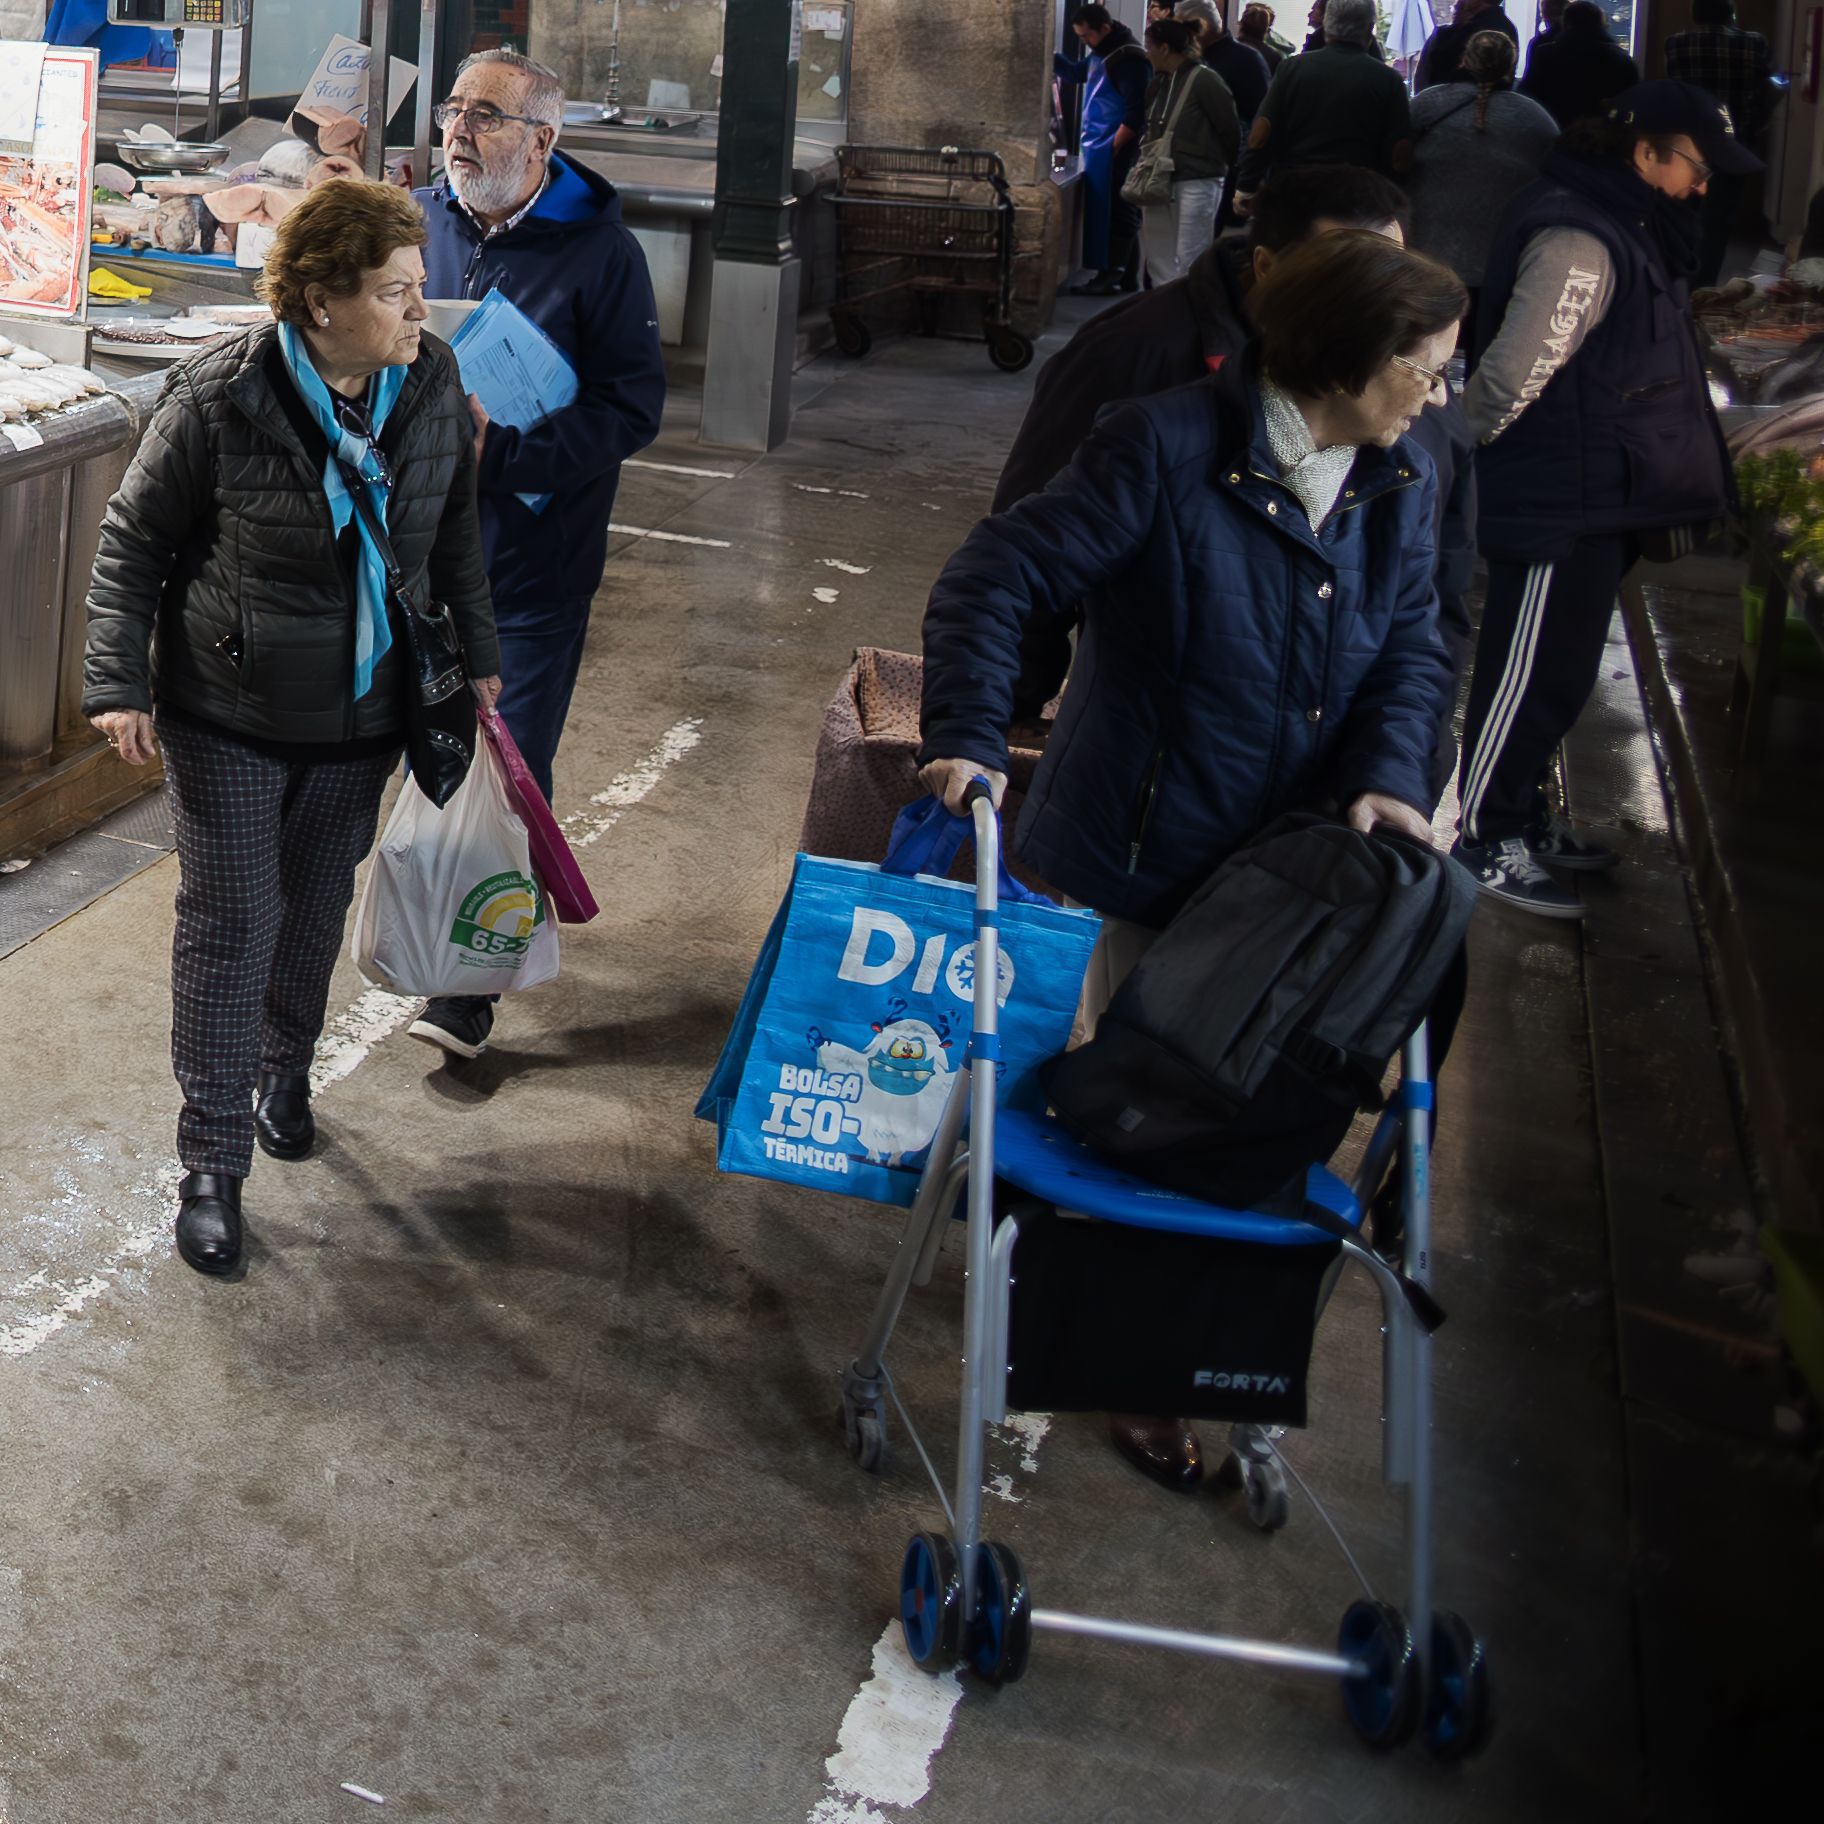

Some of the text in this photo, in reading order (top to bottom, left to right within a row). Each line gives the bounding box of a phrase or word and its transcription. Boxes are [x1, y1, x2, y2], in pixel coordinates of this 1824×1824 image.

[779, 1064, 862, 1102] BOLSA
[760, 1091, 860, 1145] ISO-
[763, 1137, 849, 1174] TÉRMICA
[1194, 1370, 1286, 1393] FORTA
